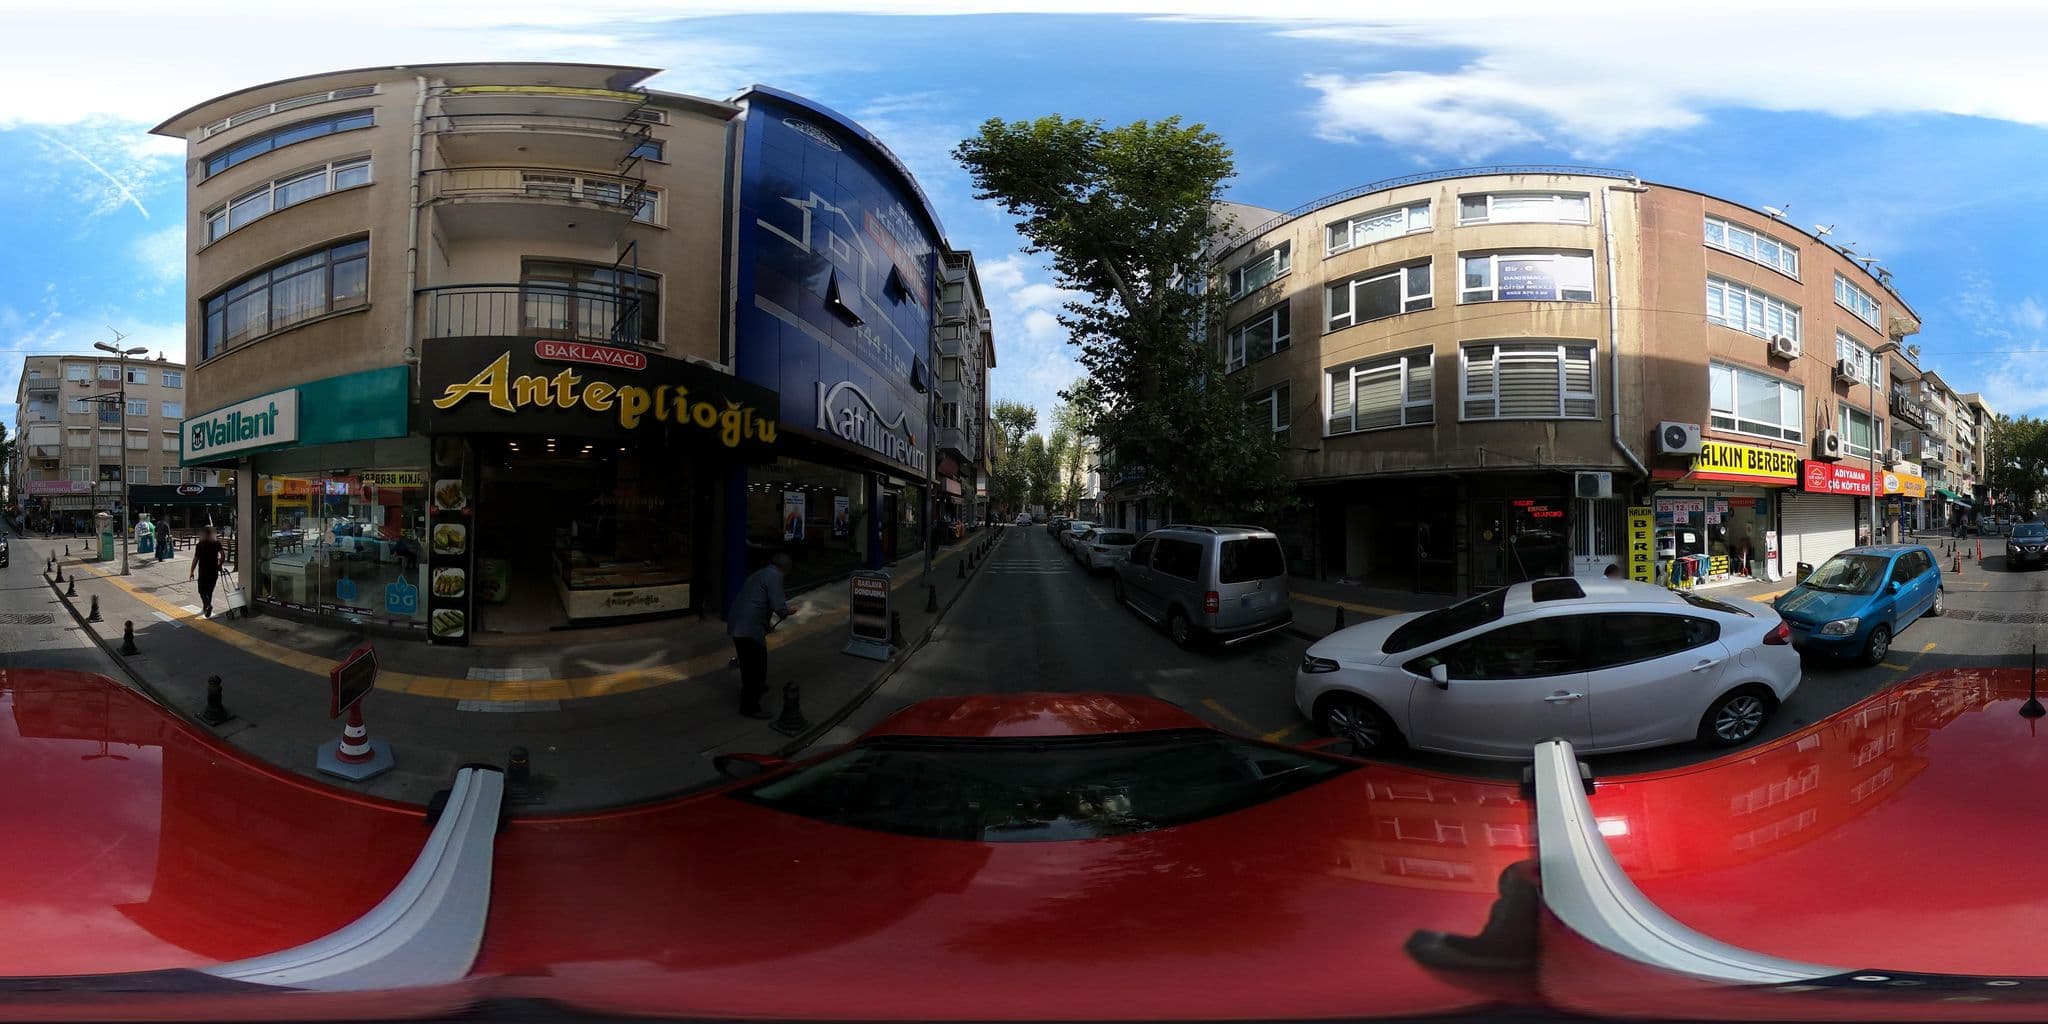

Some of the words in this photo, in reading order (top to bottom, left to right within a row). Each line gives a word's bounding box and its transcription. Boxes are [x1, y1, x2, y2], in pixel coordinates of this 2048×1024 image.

[544, 343, 640, 367] BAKLAVACI
[432, 350, 778, 447] Anteplioğlu
[206, 402, 279, 447] Vaillant
[1691, 445, 1742, 468] ALKIN
[1748, 449, 1797, 474] BERBERİ
[1828, 479, 1840, 490] ÇİĞ
[1841, 480, 1860, 491] KÖFTE
[1835, 469, 1865, 480] ADIYAMAN
